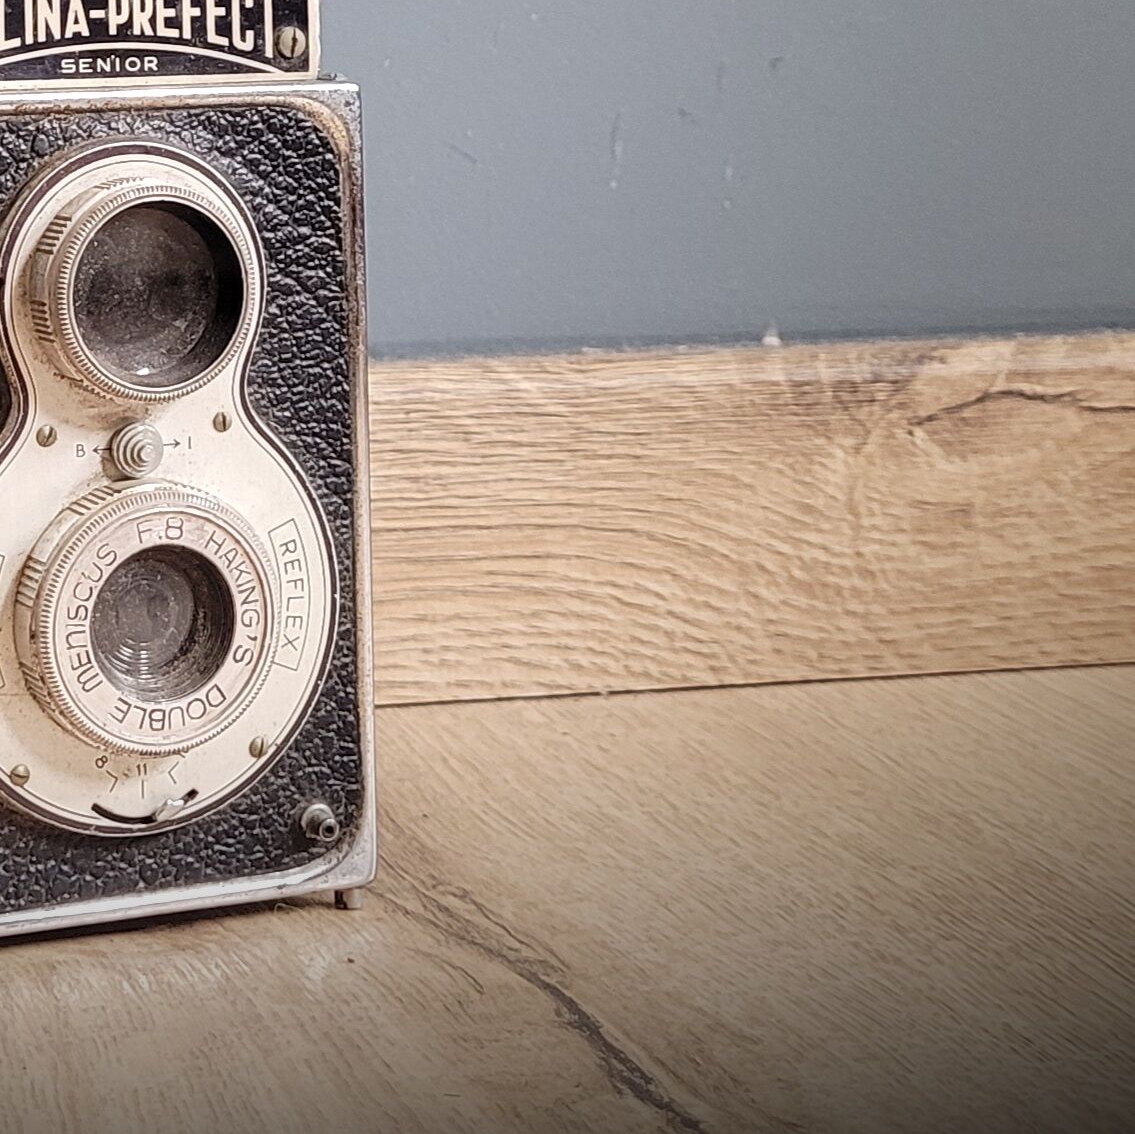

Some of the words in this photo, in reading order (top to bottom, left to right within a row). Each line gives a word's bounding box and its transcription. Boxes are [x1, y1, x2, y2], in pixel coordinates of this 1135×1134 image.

[61, 56, 158, 74] SENIOR
[75, 443, 86, 458] B
[65, 542, 118, 693] MENISCUS
[204, 530, 261, 666] HAKING'S
[280, 538, 305, 652] REFLEX
[112, 683, 227, 731] DOUBLE
